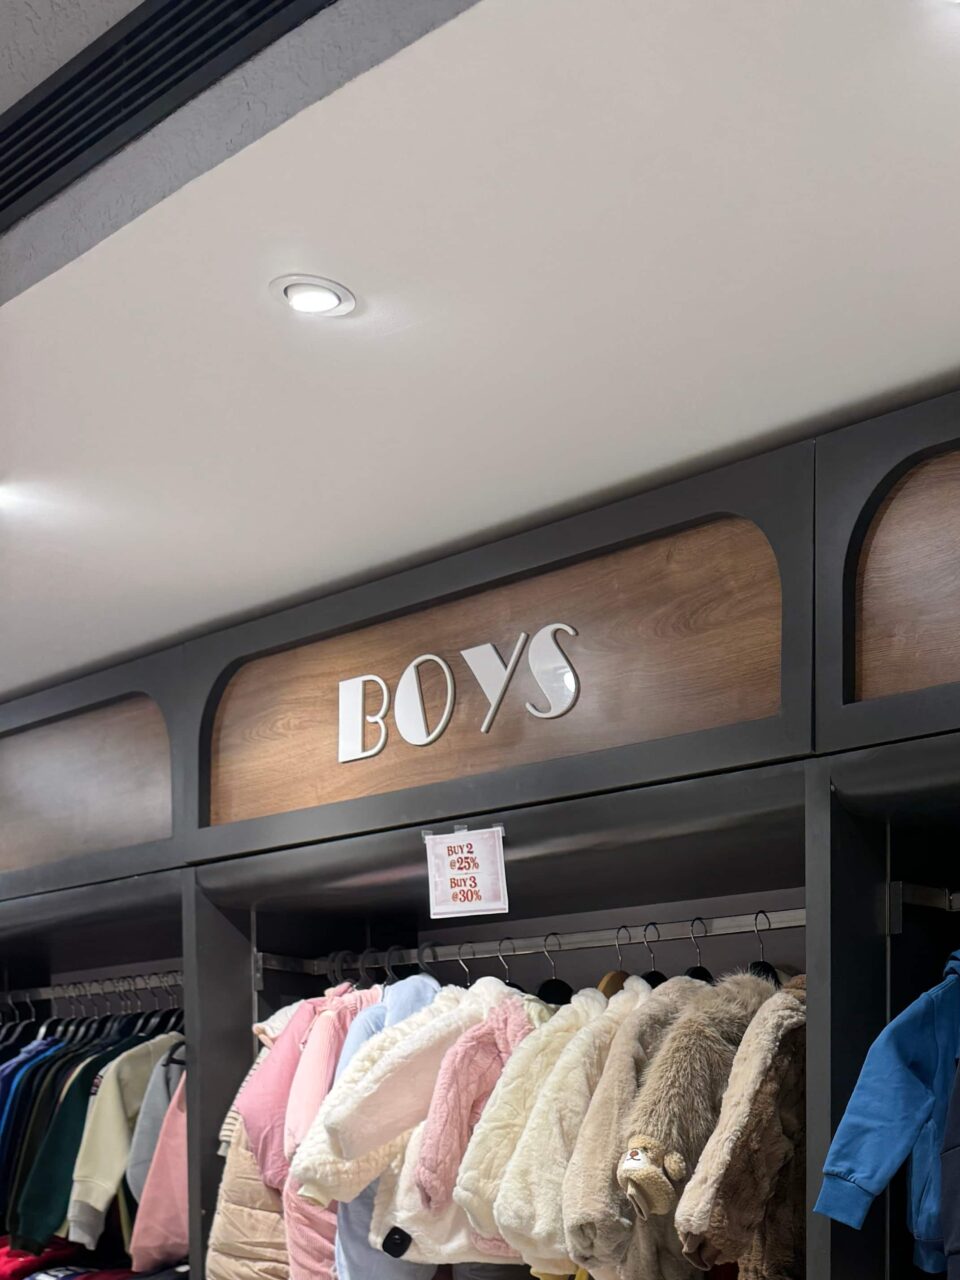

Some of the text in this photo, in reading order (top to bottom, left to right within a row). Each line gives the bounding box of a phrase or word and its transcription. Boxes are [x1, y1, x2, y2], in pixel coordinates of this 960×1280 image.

[339, 623, 580, 763] BOYS
[447, 843, 474, 856] BUY 2
[450, 857, 480, 870] @25%
[450, 876, 477, 889] BUY 3
[451, 889, 482, 902] @30%
